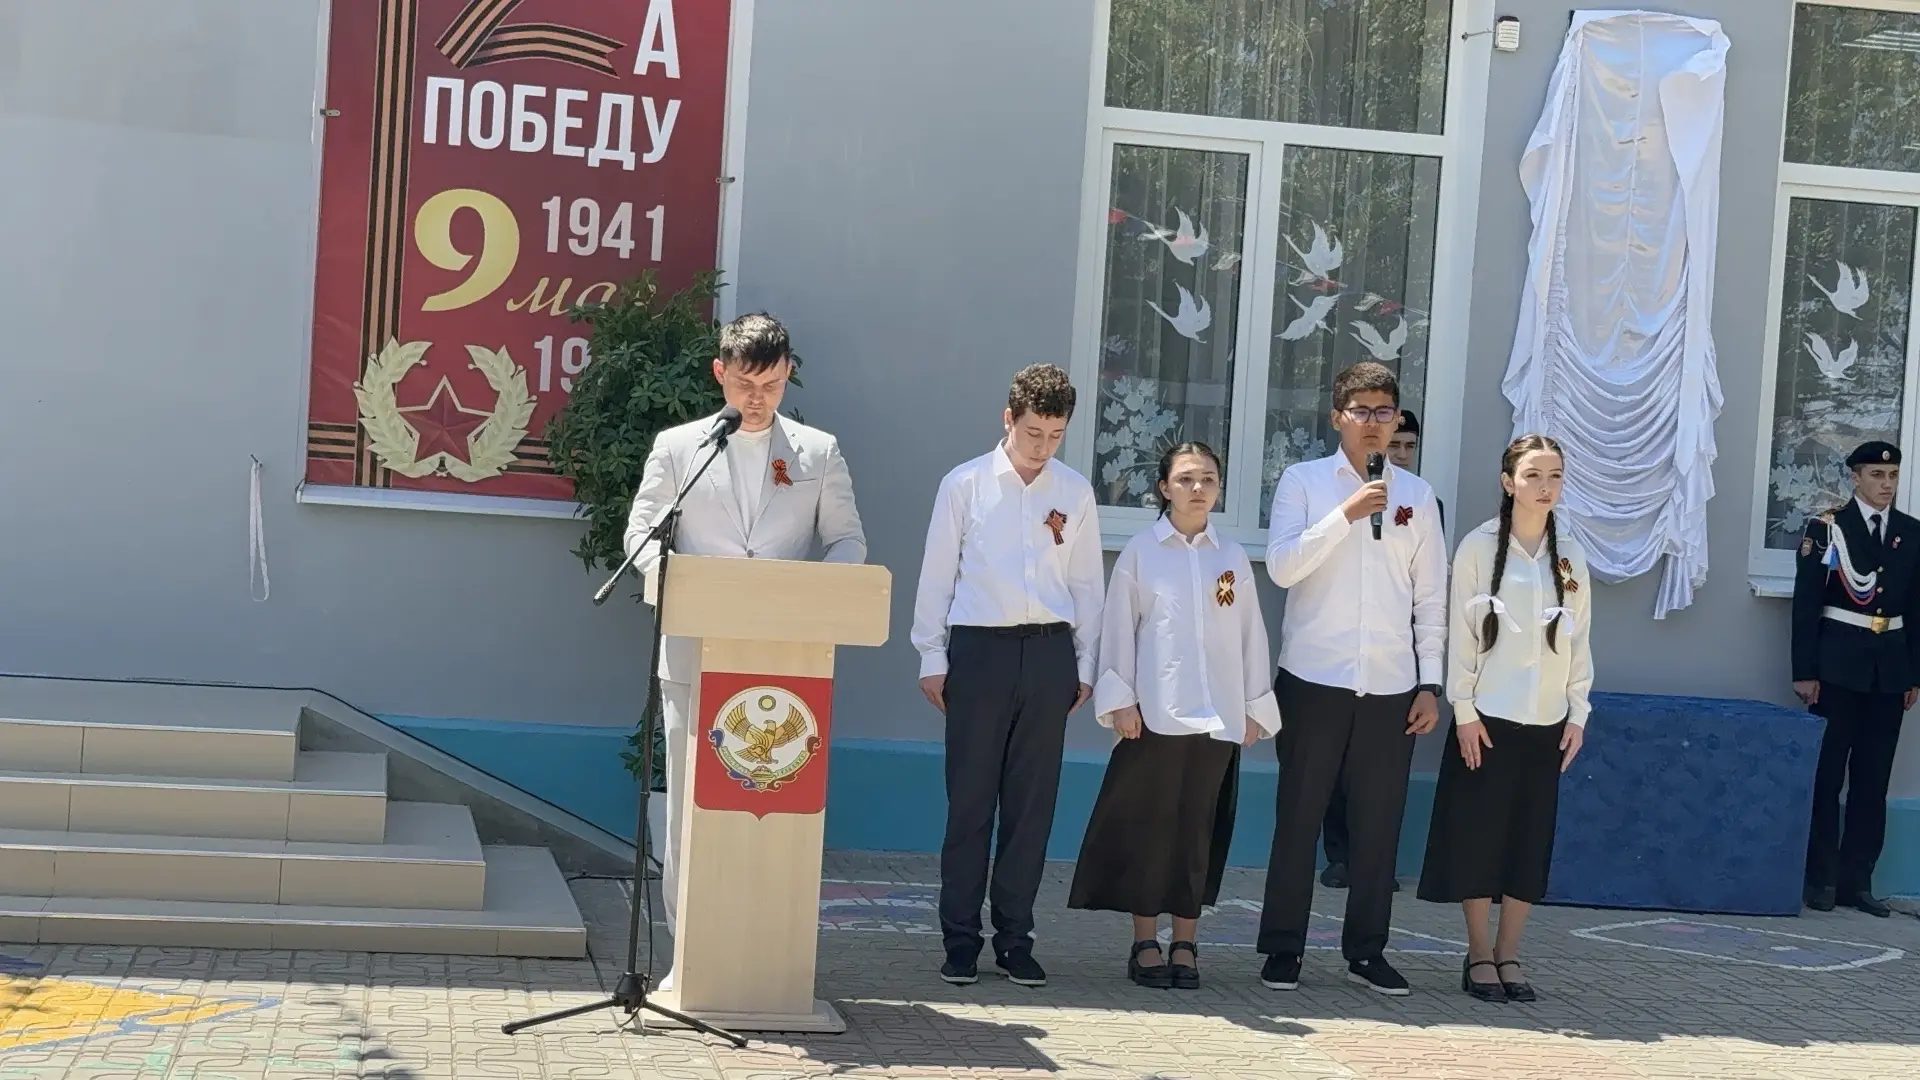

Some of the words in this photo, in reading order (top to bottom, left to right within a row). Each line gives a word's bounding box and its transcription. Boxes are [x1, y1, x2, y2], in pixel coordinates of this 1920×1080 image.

[423, 76, 682, 171] ПОБЕДУ
[414, 188, 520, 312] 9
[506, 277, 657, 317] ма
[541, 195, 665, 262] 1941
[534, 335, 594, 394] 19
